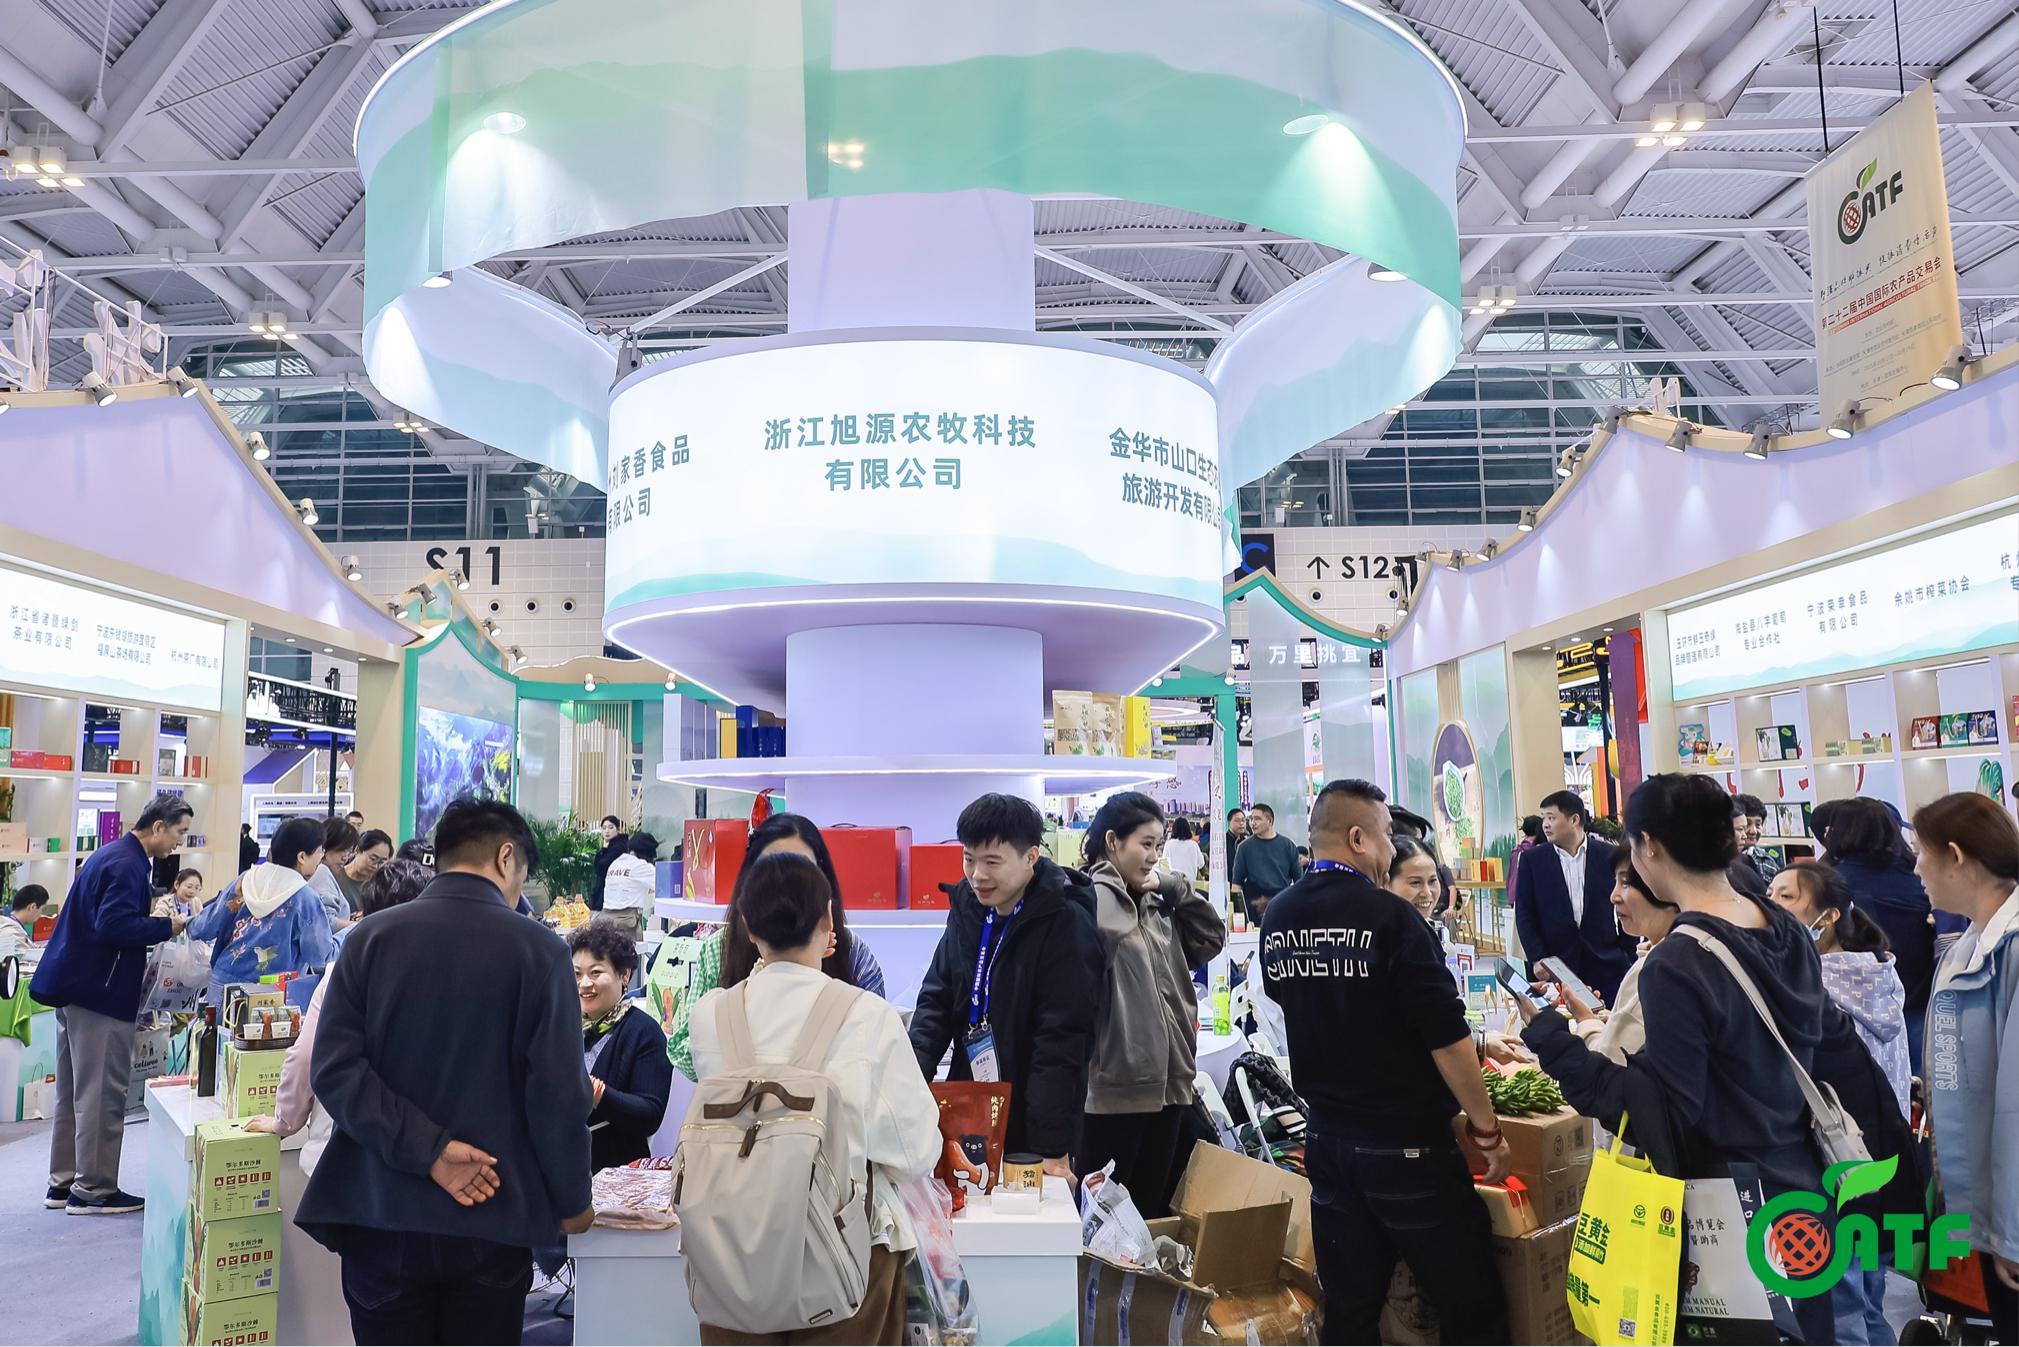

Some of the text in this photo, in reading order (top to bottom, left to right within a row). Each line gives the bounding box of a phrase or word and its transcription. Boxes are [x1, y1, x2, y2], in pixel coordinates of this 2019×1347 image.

[1838, 170, 1904, 245] CATF
[1821, 256, 1942, 330] 第二十二届中国国际农产品交易会
[763, 411, 1038, 451] 浙江旭源农牧科技
[824, 456, 963, 492] 有限公司
[1341, 555, 1389, 579] S12
[2000, 550, 2018, 571] 杭
[1894, 575, 1970, 608] 余姚市榨菜协会
[1935, 1034, 1959, 1091] SPORTS
[1692, 1297, 1727, 1306] MANUAL
